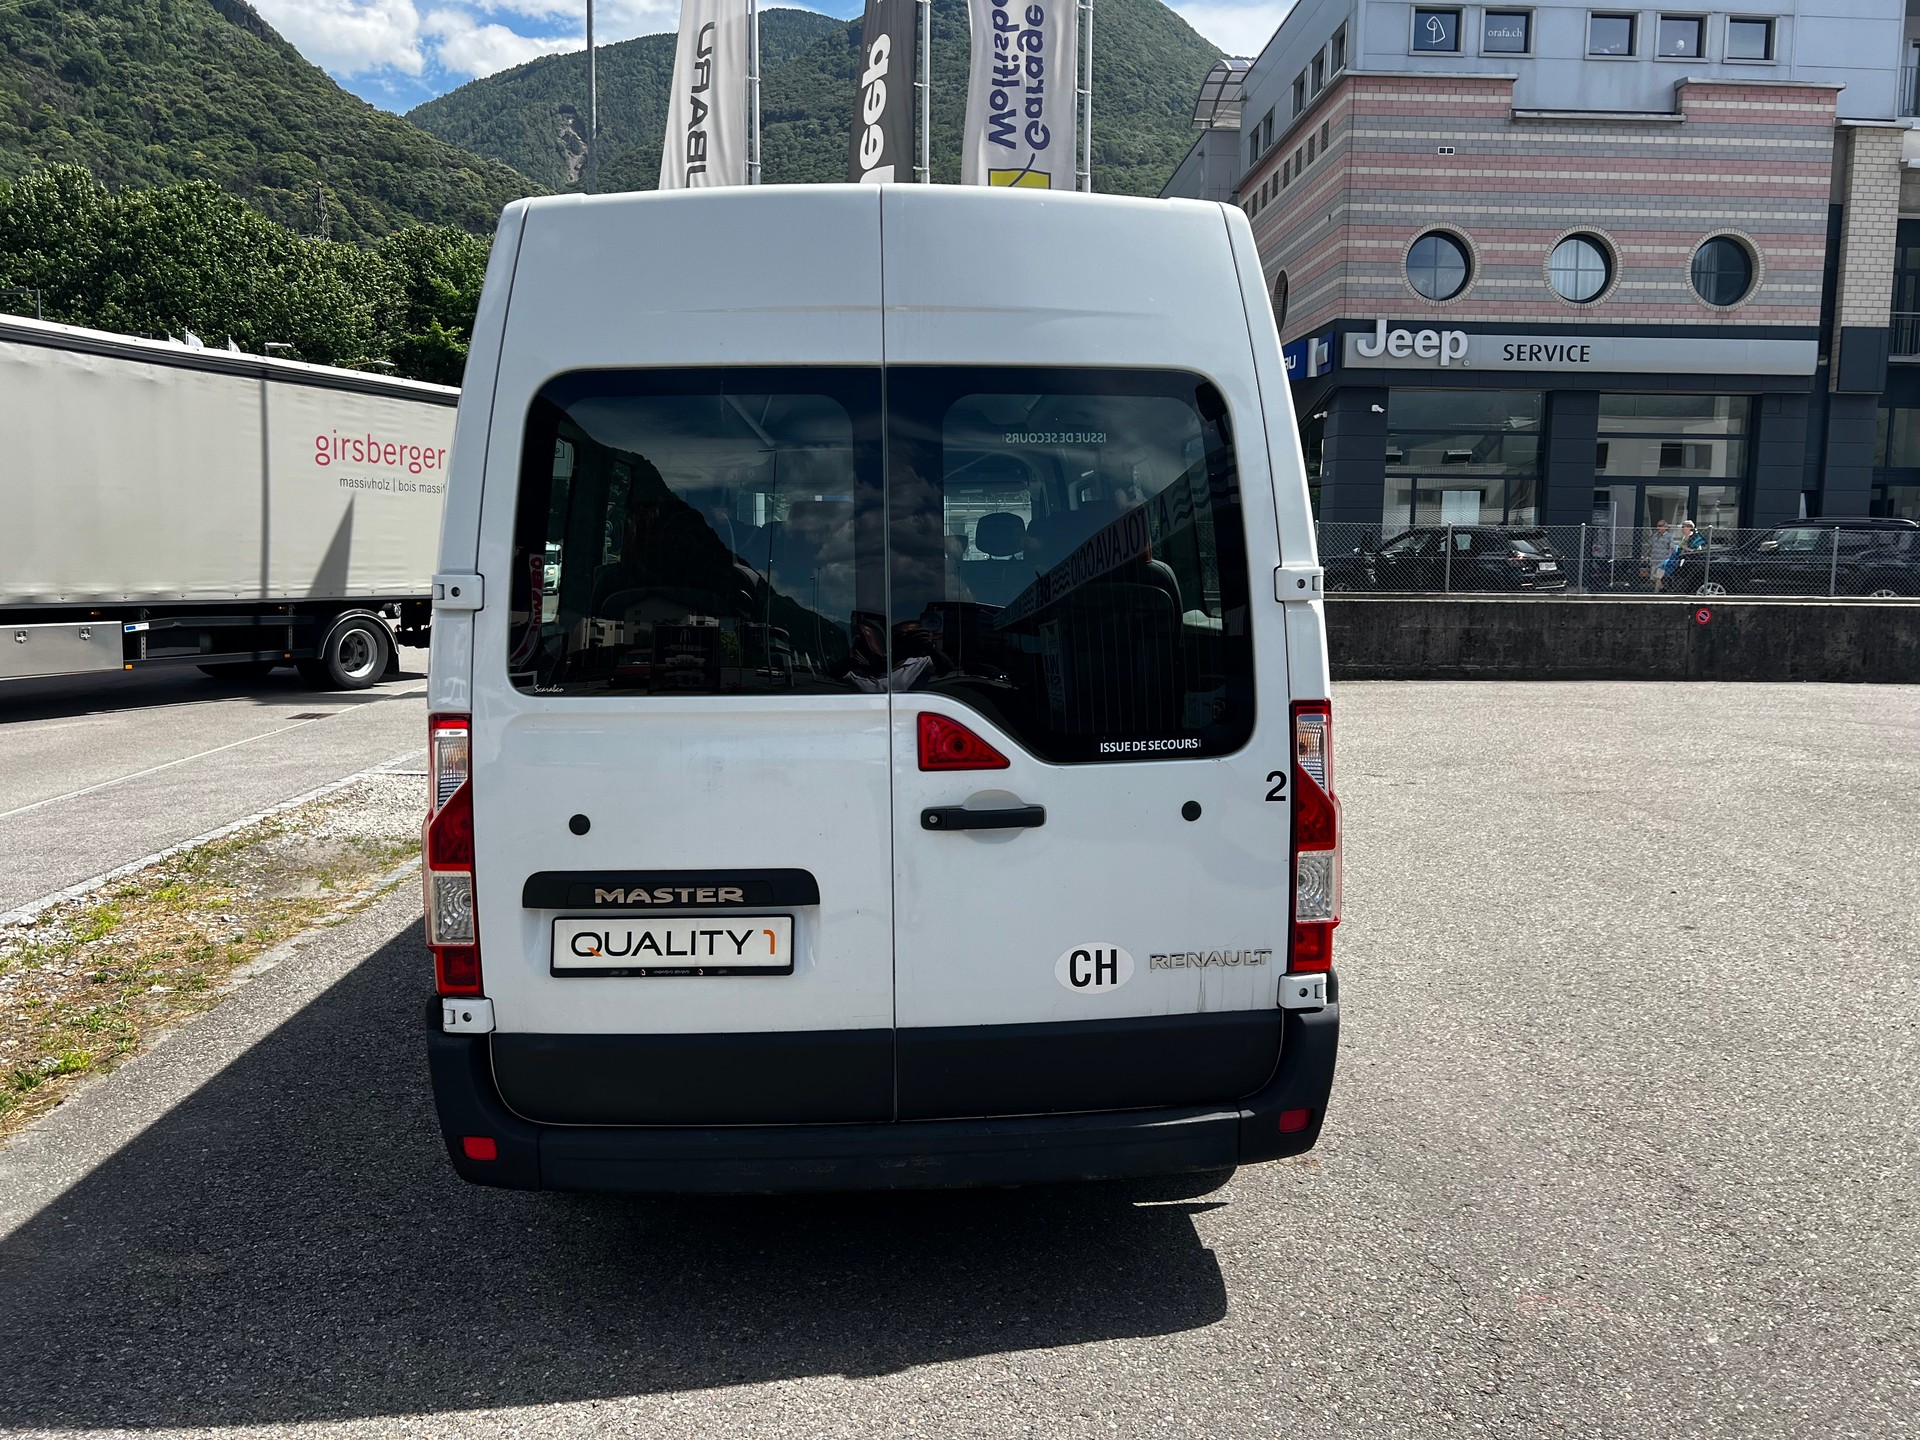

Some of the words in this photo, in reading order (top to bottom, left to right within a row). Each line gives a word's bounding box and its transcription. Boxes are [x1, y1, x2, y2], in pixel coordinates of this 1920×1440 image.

[1487, 27, 1523, 38] orafa.ch
[1356, 319, 1469, 367] Jeep
[1503, 343, 1591, 363] SERVICE
[315, 429, 446, 475] girsberger
[339, 477, 390, 491] massivholz
[398, 480, 417, 493] bois
[419, 482, 446, 495] massi
[1100, 741, 1131, 753] ISSUE
[1132, 740, 1147, 752] DE
[1148, 738, 1198, 751] SECOURS
[1265, 770, 1288, 803] 2
[594, 887, 744, 904] MASTER
[571, 930, 754, 957] QUALITY
[763, 929, 776, 955] 1
[1069, 948, 1118, 988] CH
[1149, 948, 1273, 971] RENAULT
